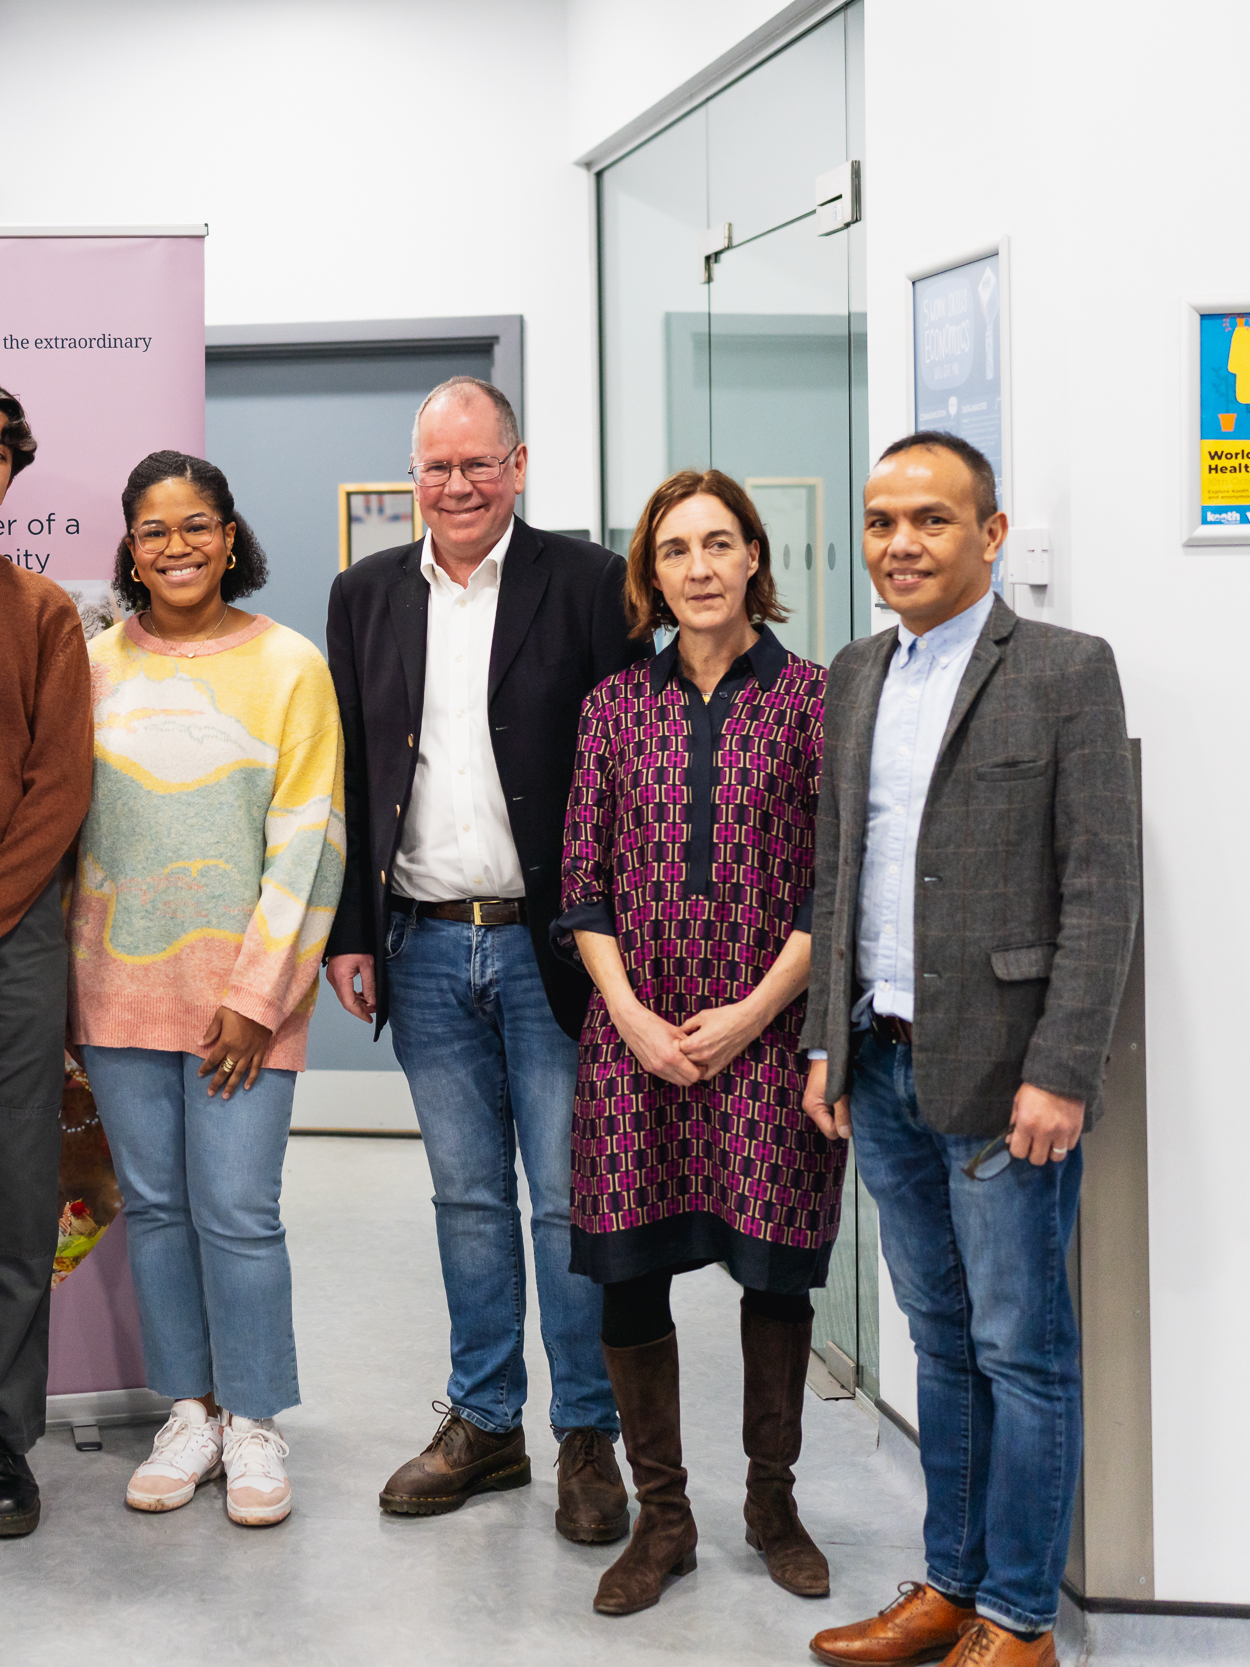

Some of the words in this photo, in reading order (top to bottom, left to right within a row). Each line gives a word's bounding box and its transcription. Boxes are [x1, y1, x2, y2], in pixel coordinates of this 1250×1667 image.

[2, 333, 30, 350] the
[34, 333, 153, 353] extraordinary
[1208, 463, 1250, 474] Healt
[27, 512, 56, 536] of
[65, 518, 80, 535] a
